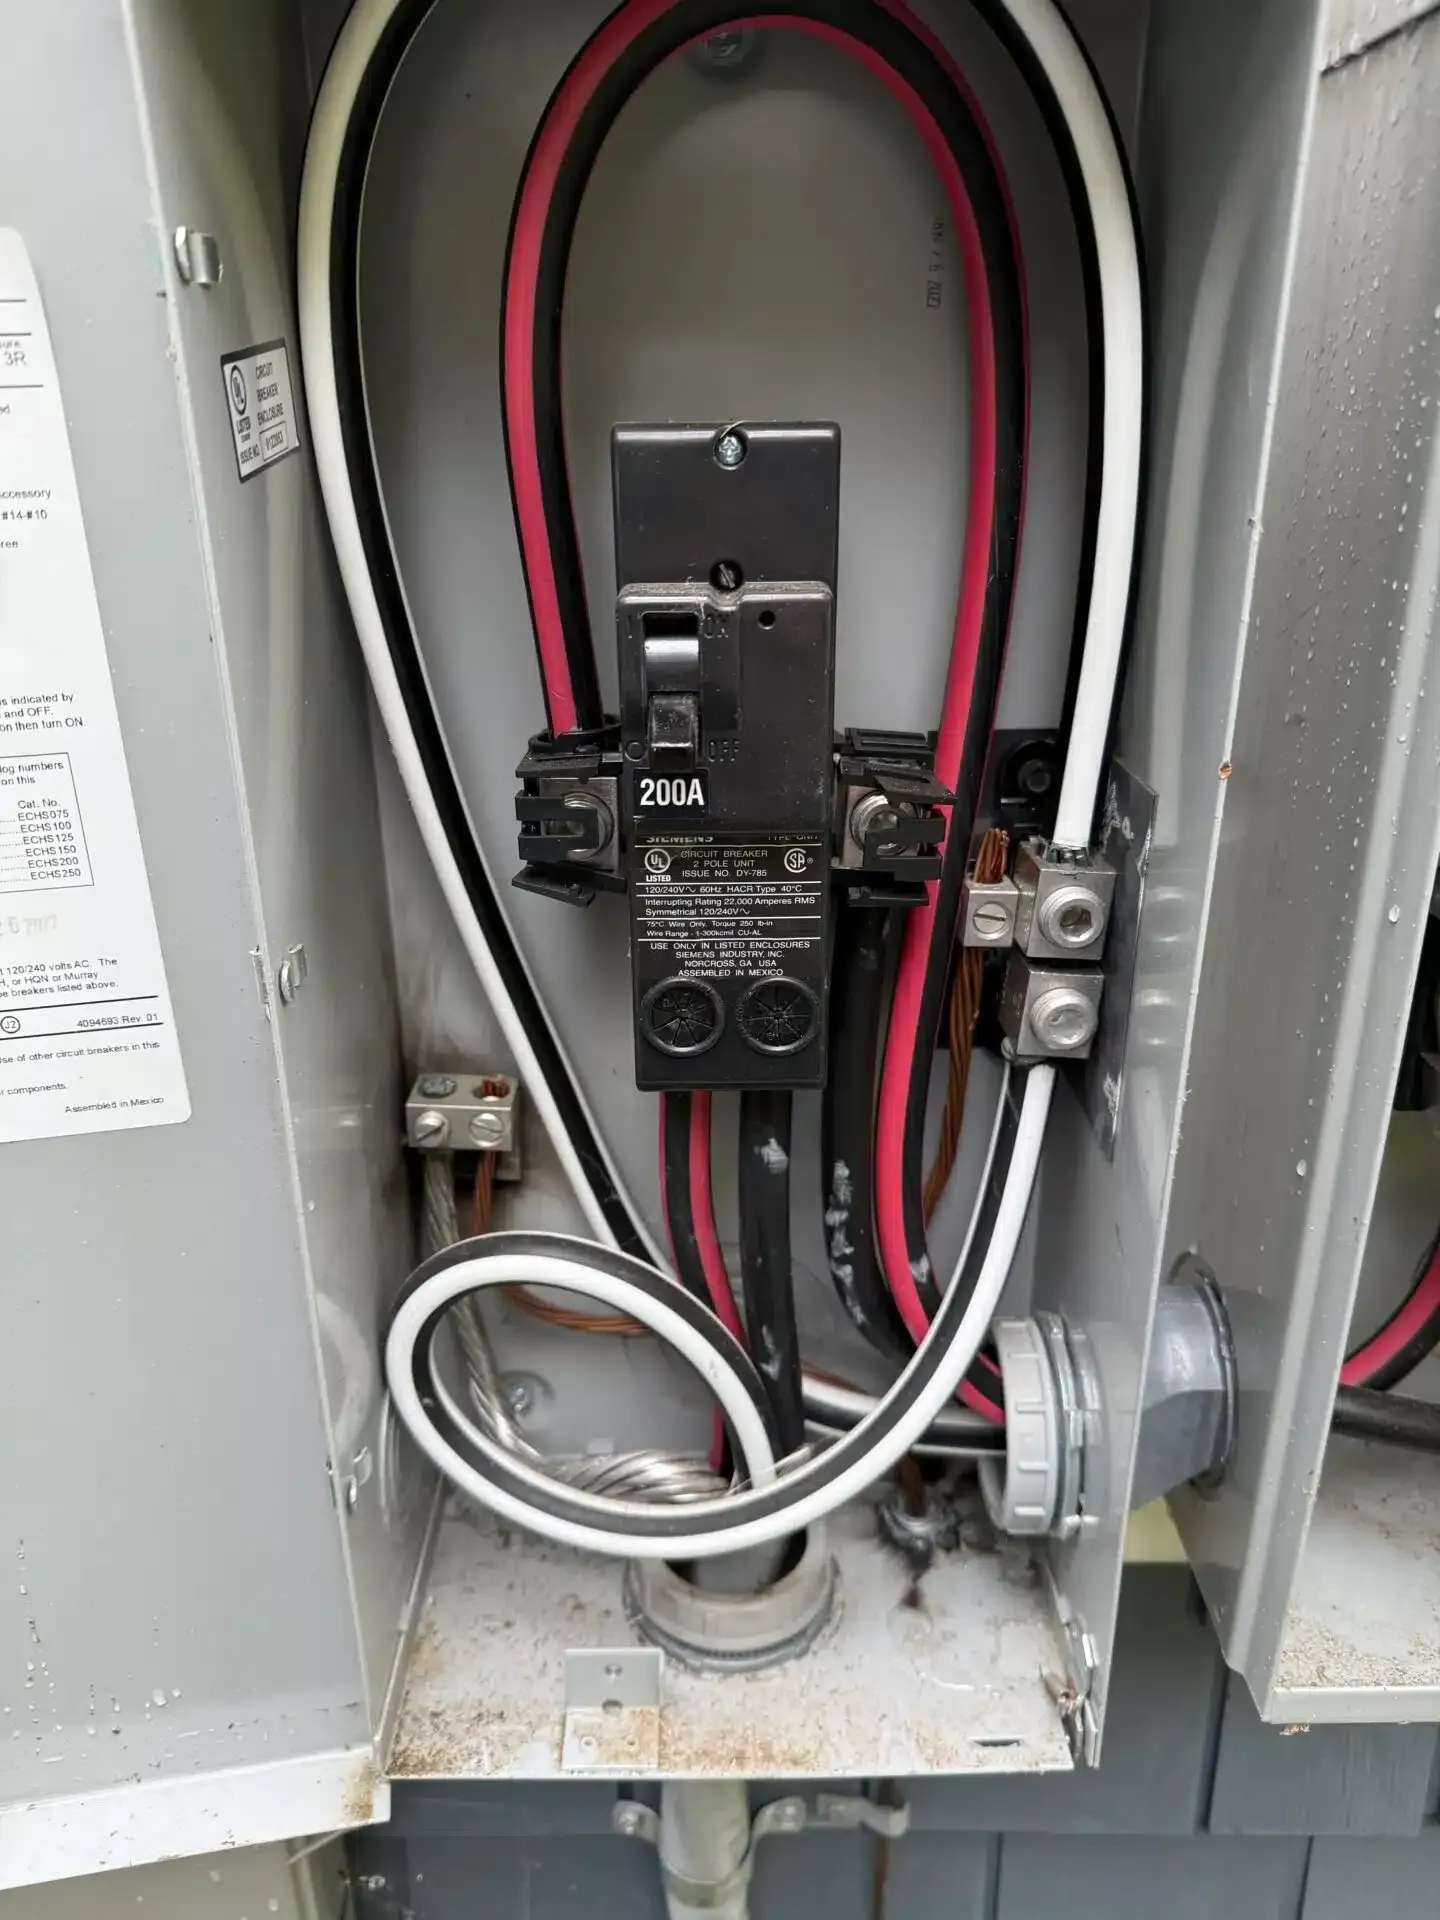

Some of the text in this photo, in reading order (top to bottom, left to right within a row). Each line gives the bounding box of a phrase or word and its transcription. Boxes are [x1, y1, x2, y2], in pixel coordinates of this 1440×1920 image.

[4, 352, 26, 365] 3R
[255, 362, 273, 380] CIRCUIT
[256, 383, 279, 403] BREAKER
[257, 403, 284, 426] ENCLOSURE
[11, 693, 58, 704] indicated
[61, 692, 74, 703] by
[4, 707, 53, 718] and OFF.
[15, 720, 38, 731] then
[42, 719, 62, 729] turn
[65, 717, 83, 727] ON
[18, 761, 64, 773] numbers
[1, 775, 36, 786] on this
[640, 778, 705, 806] 200A
[18, 798, 60, 809] Cat. No.
[680, 849, 768, 858] CIRCUIT BREAKER
[645, 874, 672, 882] LISTED
[682, 869, 767, 878] ISSUE NO. DY-785
[700, 885, 722, 893] 60Hz
[727, 885, 753, 893] HACR
[756, 885, 776, 894] Type
[781, 884, 802, 893] 40°C
[645, 896, 816, 907] Interrupting Rating 22,000 Amperes RMS
[645, 907, 697, 917] Symmetrical
[646, 920, 665, 928] 75°C
[712, 920, 736, 929] Torque
[665, 930, 688, 938] Range
[651, 942, 669, 950] USE
[673, 942, 697, 950] ONLY
[750, 941, 810, 949] ENCLOSURES
[676, 951, 715, 959] SIEMENS
[720, 951, 766, 959] INDUSTRY,
[6, 963, 46, 976] 120/240
[49, 961, 72, 972] volts
[74, 959, 92, 969] AC.
[98, 958, 118, 966] The
[685, 960, 737, 968] NORCROSS,
[758, 959, 777, 967] USA
[12, 977, 21, 985] or
[24, 973, 49, 984] HQN
[52, 974, 61, 982] or
[65, 971, 99, 983] Murray
[678, 969, 731, 977] ASSEMBLED
[749, 968, 784, 976] MEXICO
[12, 984, 54, 998] breakers
[57, 982, 82, 993] listed
[147, 1013, 158, 1022] 01
[17, 1053, 26, 1062] of
[29, 1051, 53, 1061] other
[56, 1047, 84, 1059] circuit
[87, 1045, 129, 1056] breakers
[132, 1042, 140, 1051] in
[142, 1041, 160, 1049] this
[65, 1097, 164, 1114] Assembled in Mexico
